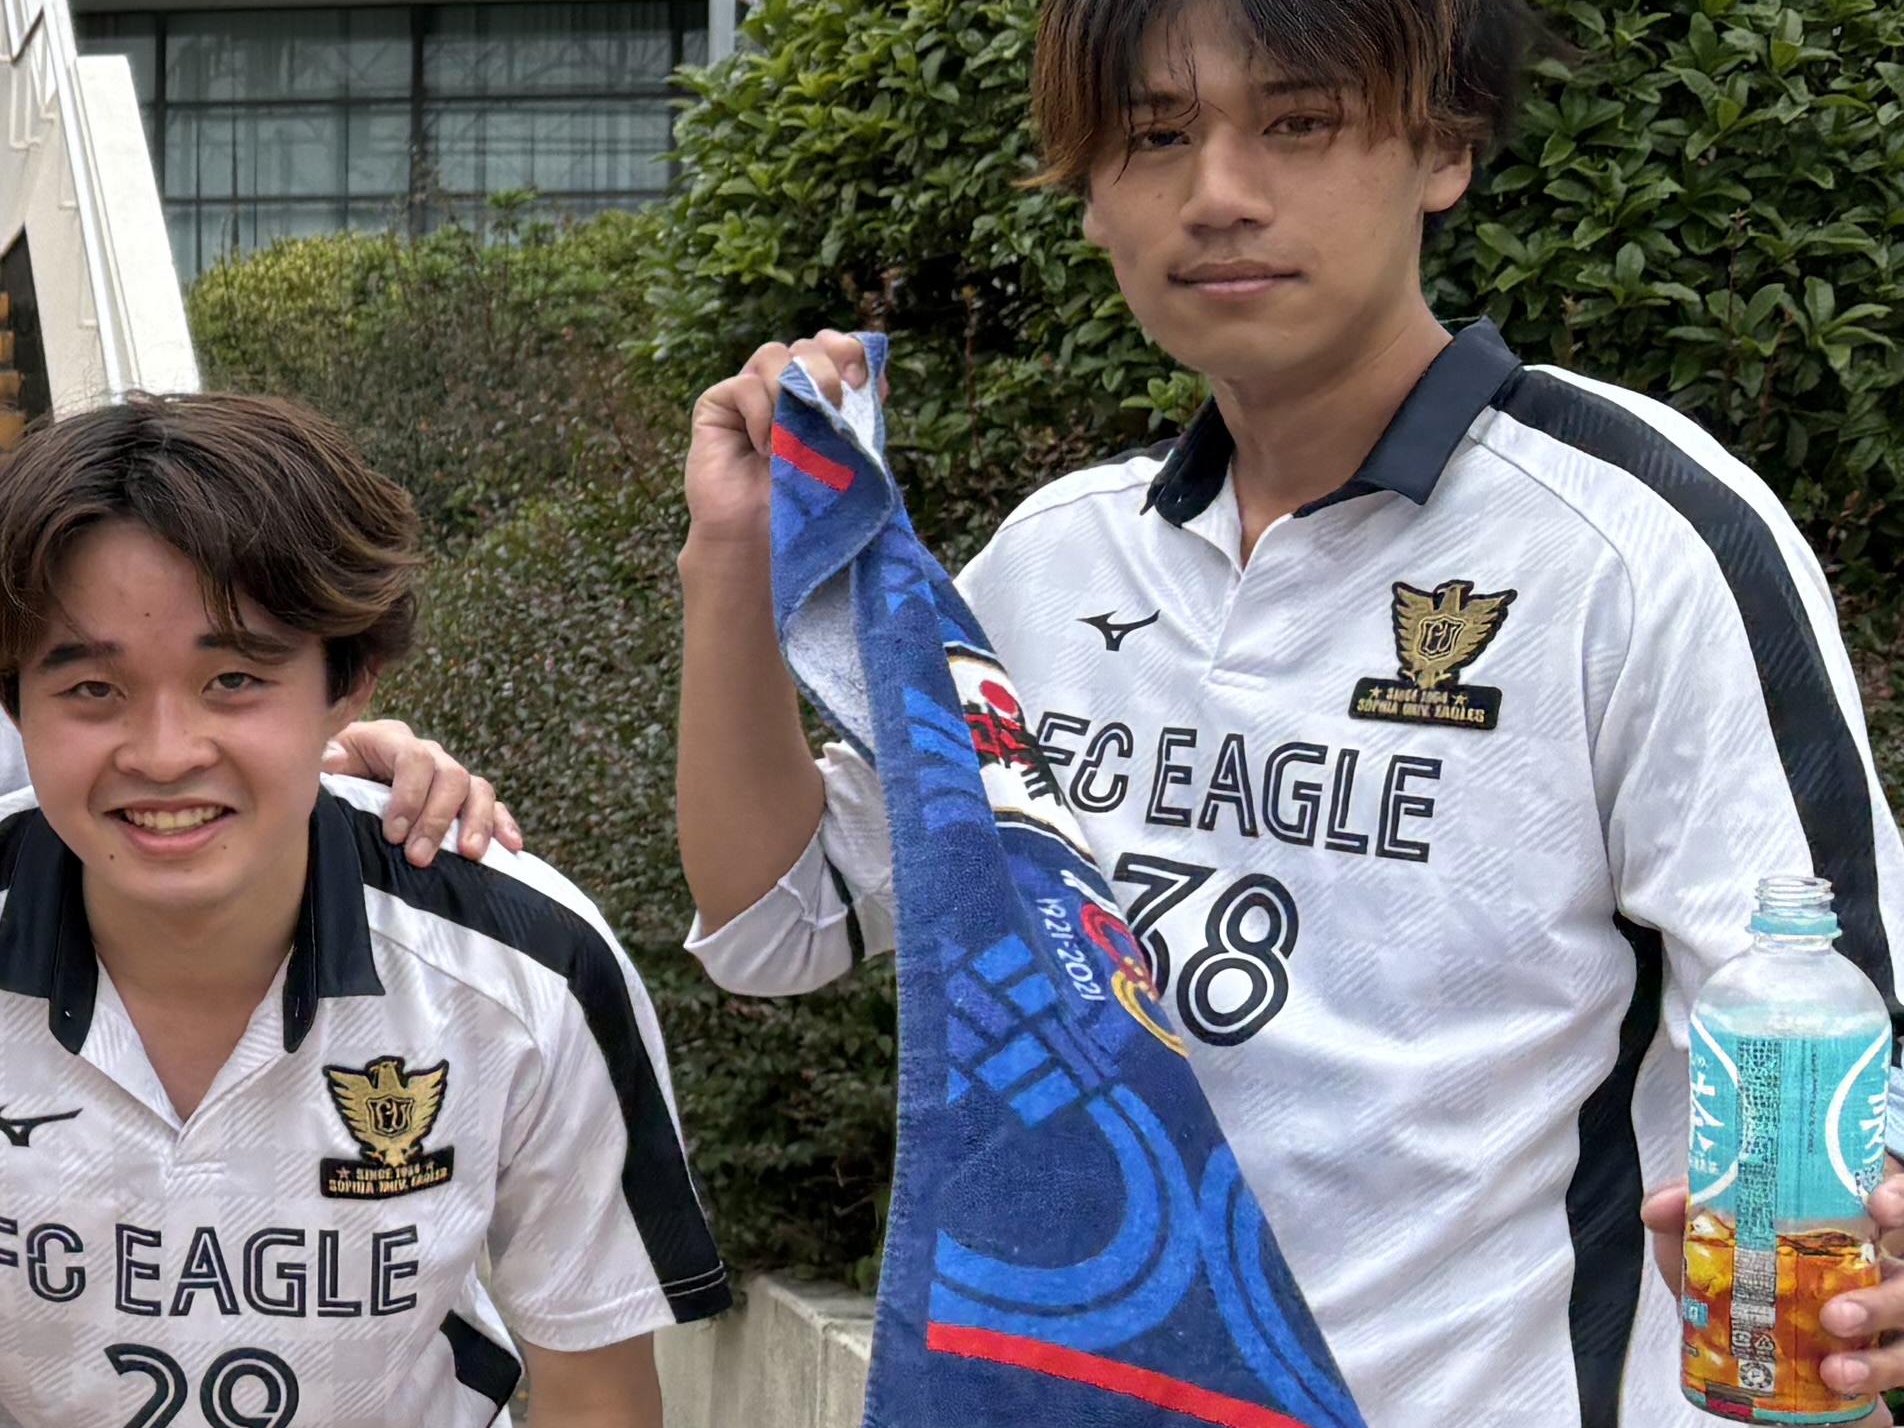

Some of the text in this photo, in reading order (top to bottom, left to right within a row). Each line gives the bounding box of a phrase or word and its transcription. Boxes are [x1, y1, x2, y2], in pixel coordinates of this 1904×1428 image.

[1036, 710, 1133, 813] FC
[1144, 725, 1444, 866] EAGLE
[1109, 849, 1299, 1048] 38
[114, 1224, 419, 1319] EAGLE
